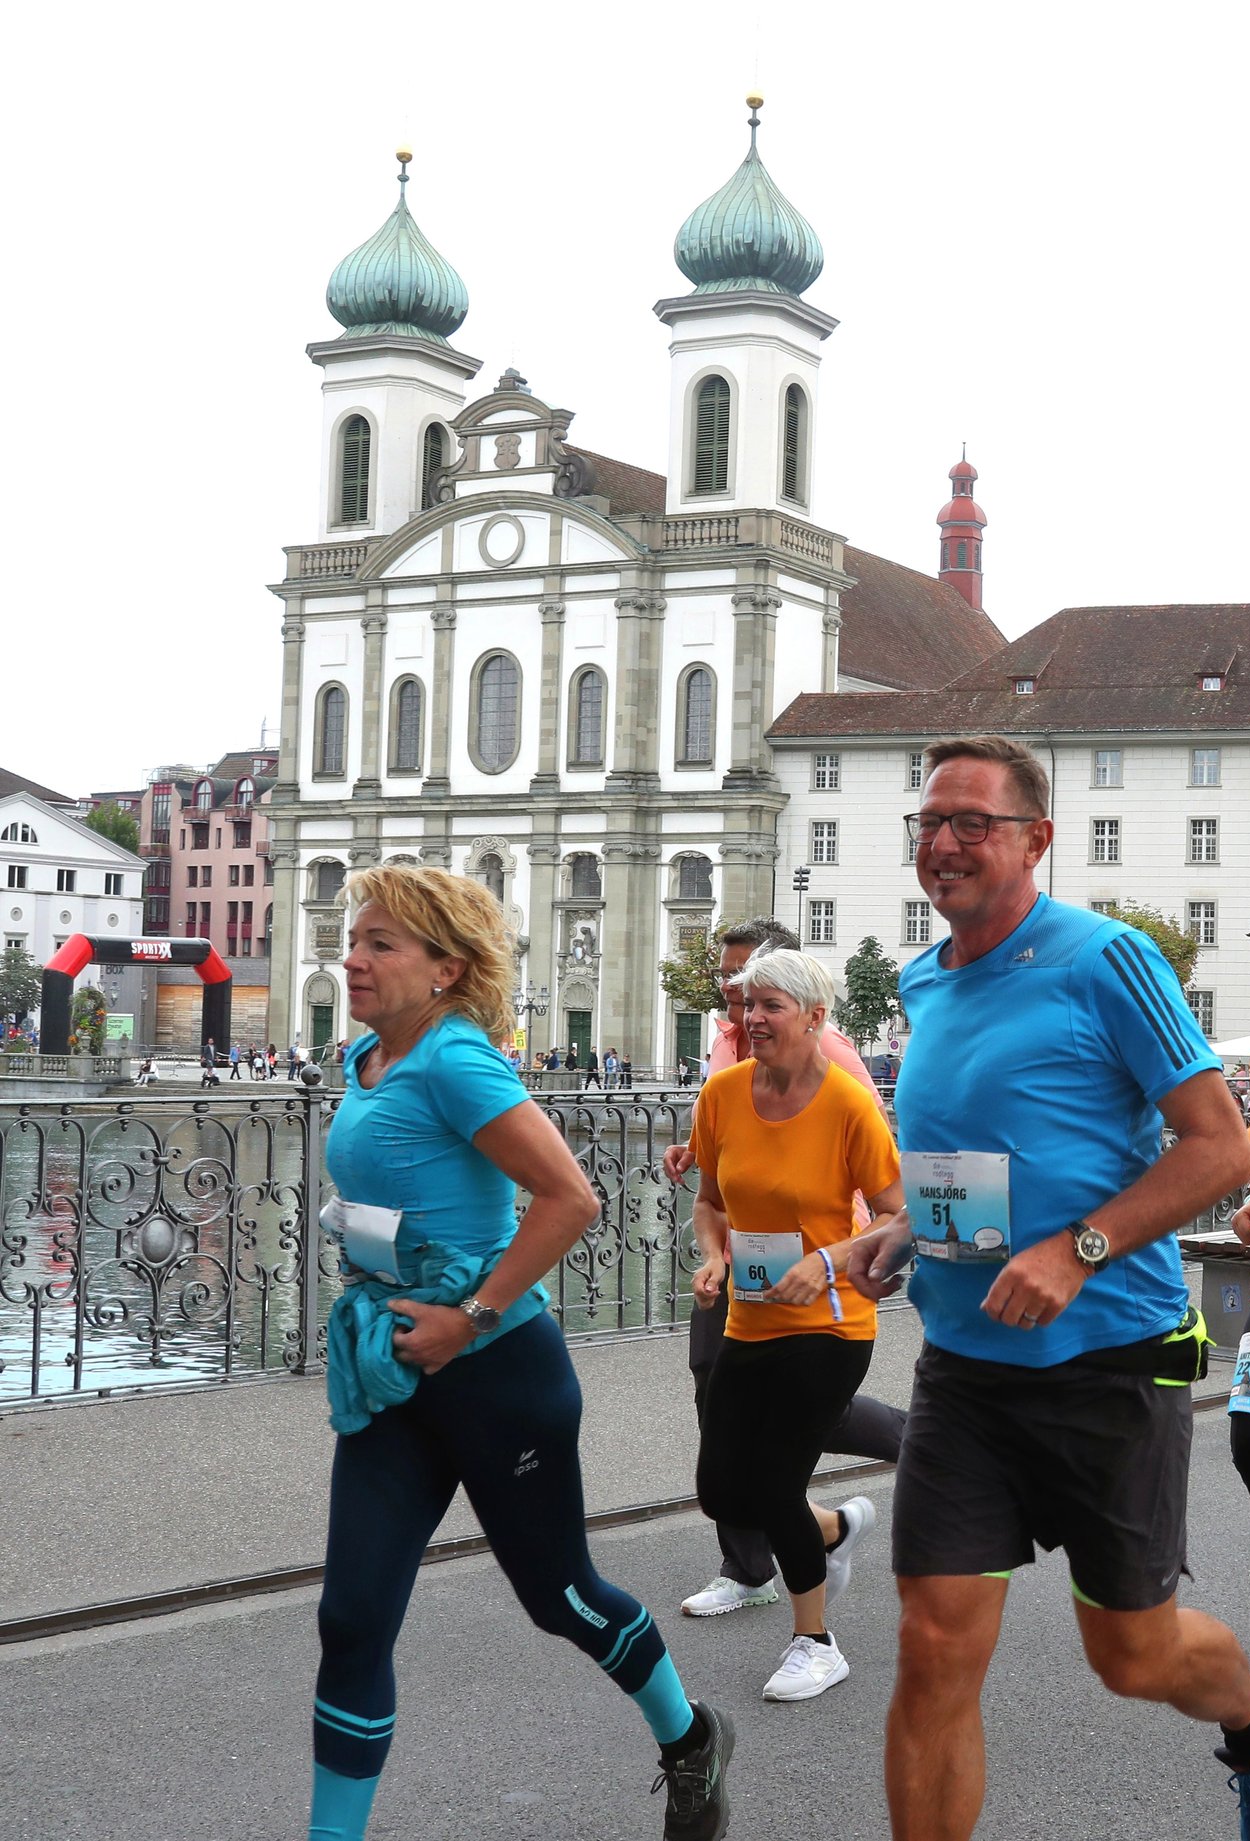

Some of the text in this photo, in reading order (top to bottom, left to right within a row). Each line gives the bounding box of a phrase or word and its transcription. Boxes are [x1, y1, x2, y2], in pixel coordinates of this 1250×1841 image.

[131, 942, 172, 959] SPORTXX
[919, 1184, 967, 1201] HANSJÖRG
[932, 1203, 951, 1226] 51
[748, 1264, 767, 1281] 60
